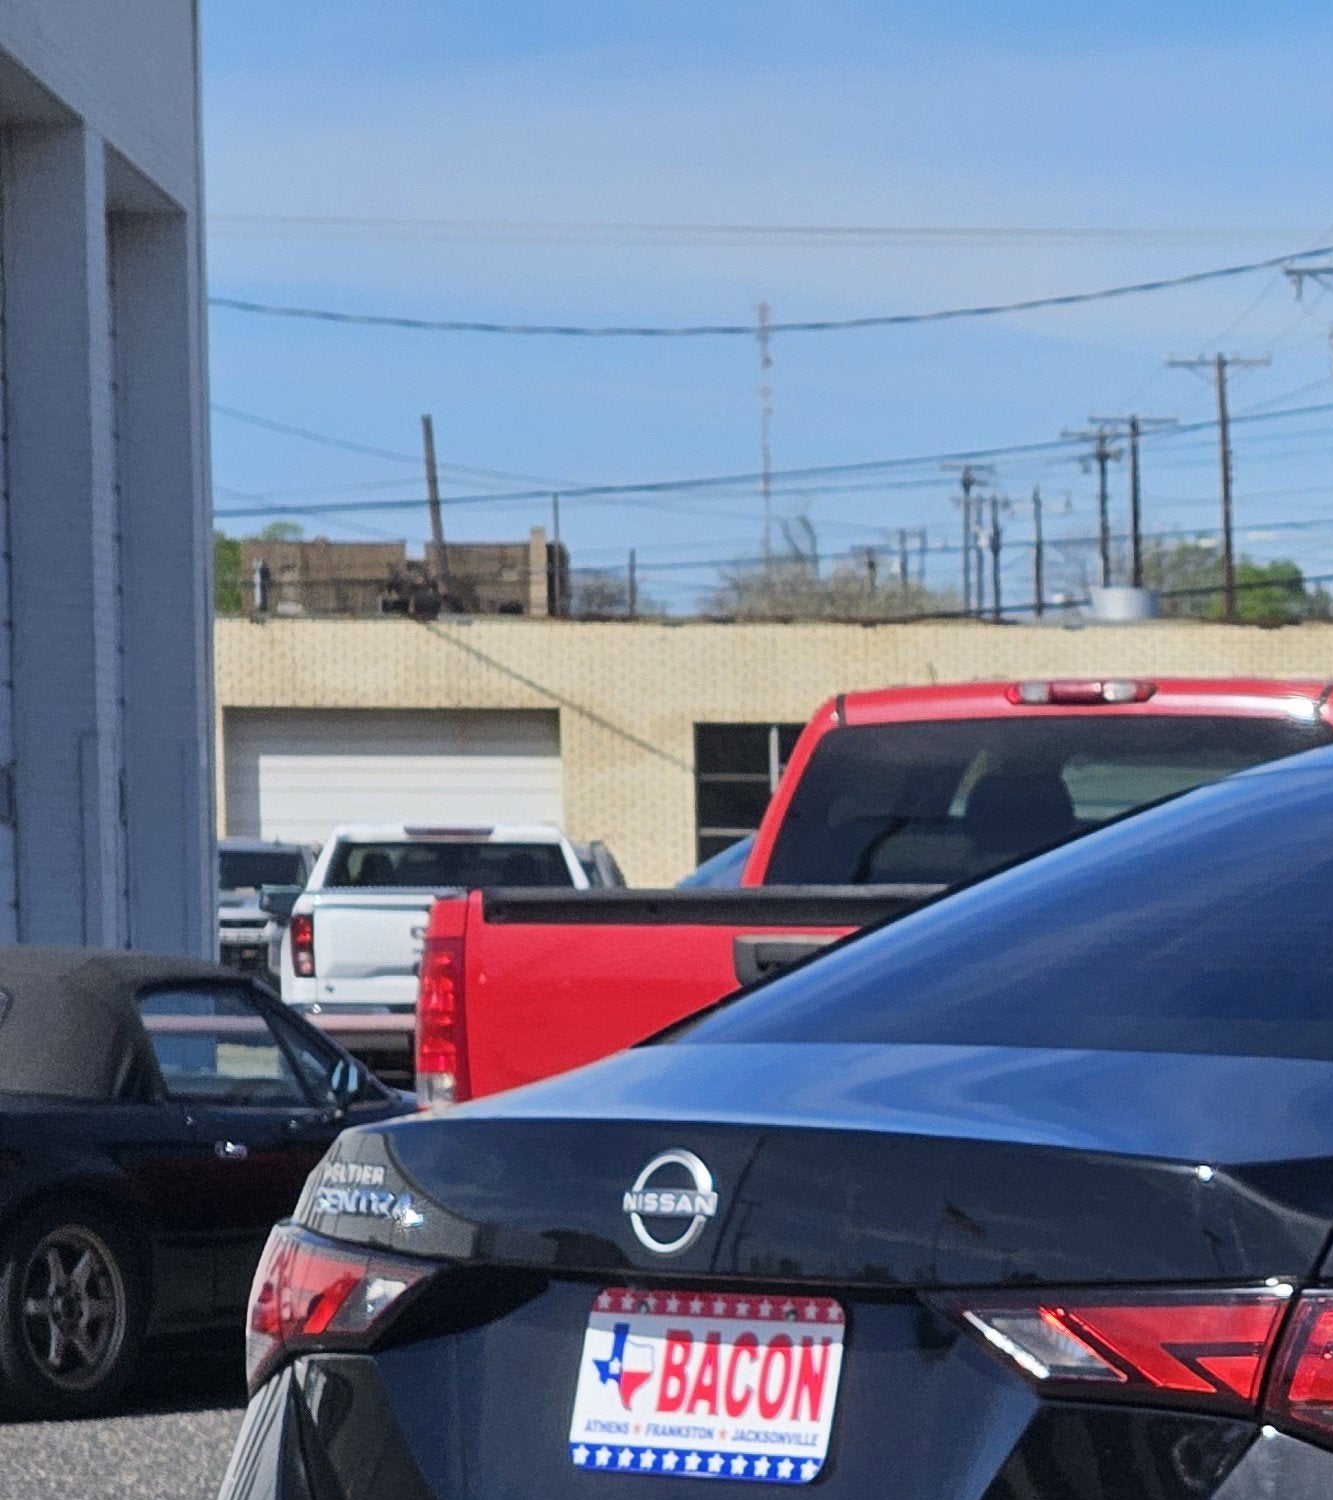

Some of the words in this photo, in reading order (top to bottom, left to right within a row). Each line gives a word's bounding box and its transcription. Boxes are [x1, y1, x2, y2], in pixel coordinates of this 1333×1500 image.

[623, 1191, 718, 1216] NISSAN
[656, 1328, 833, 1422] BACON
[584, 1418, 630, 1435] ATHENS
[644, 1422, 715, 1440] FRANKSTON
[731, 1428, 820, 1447] JACKSONVILLE
